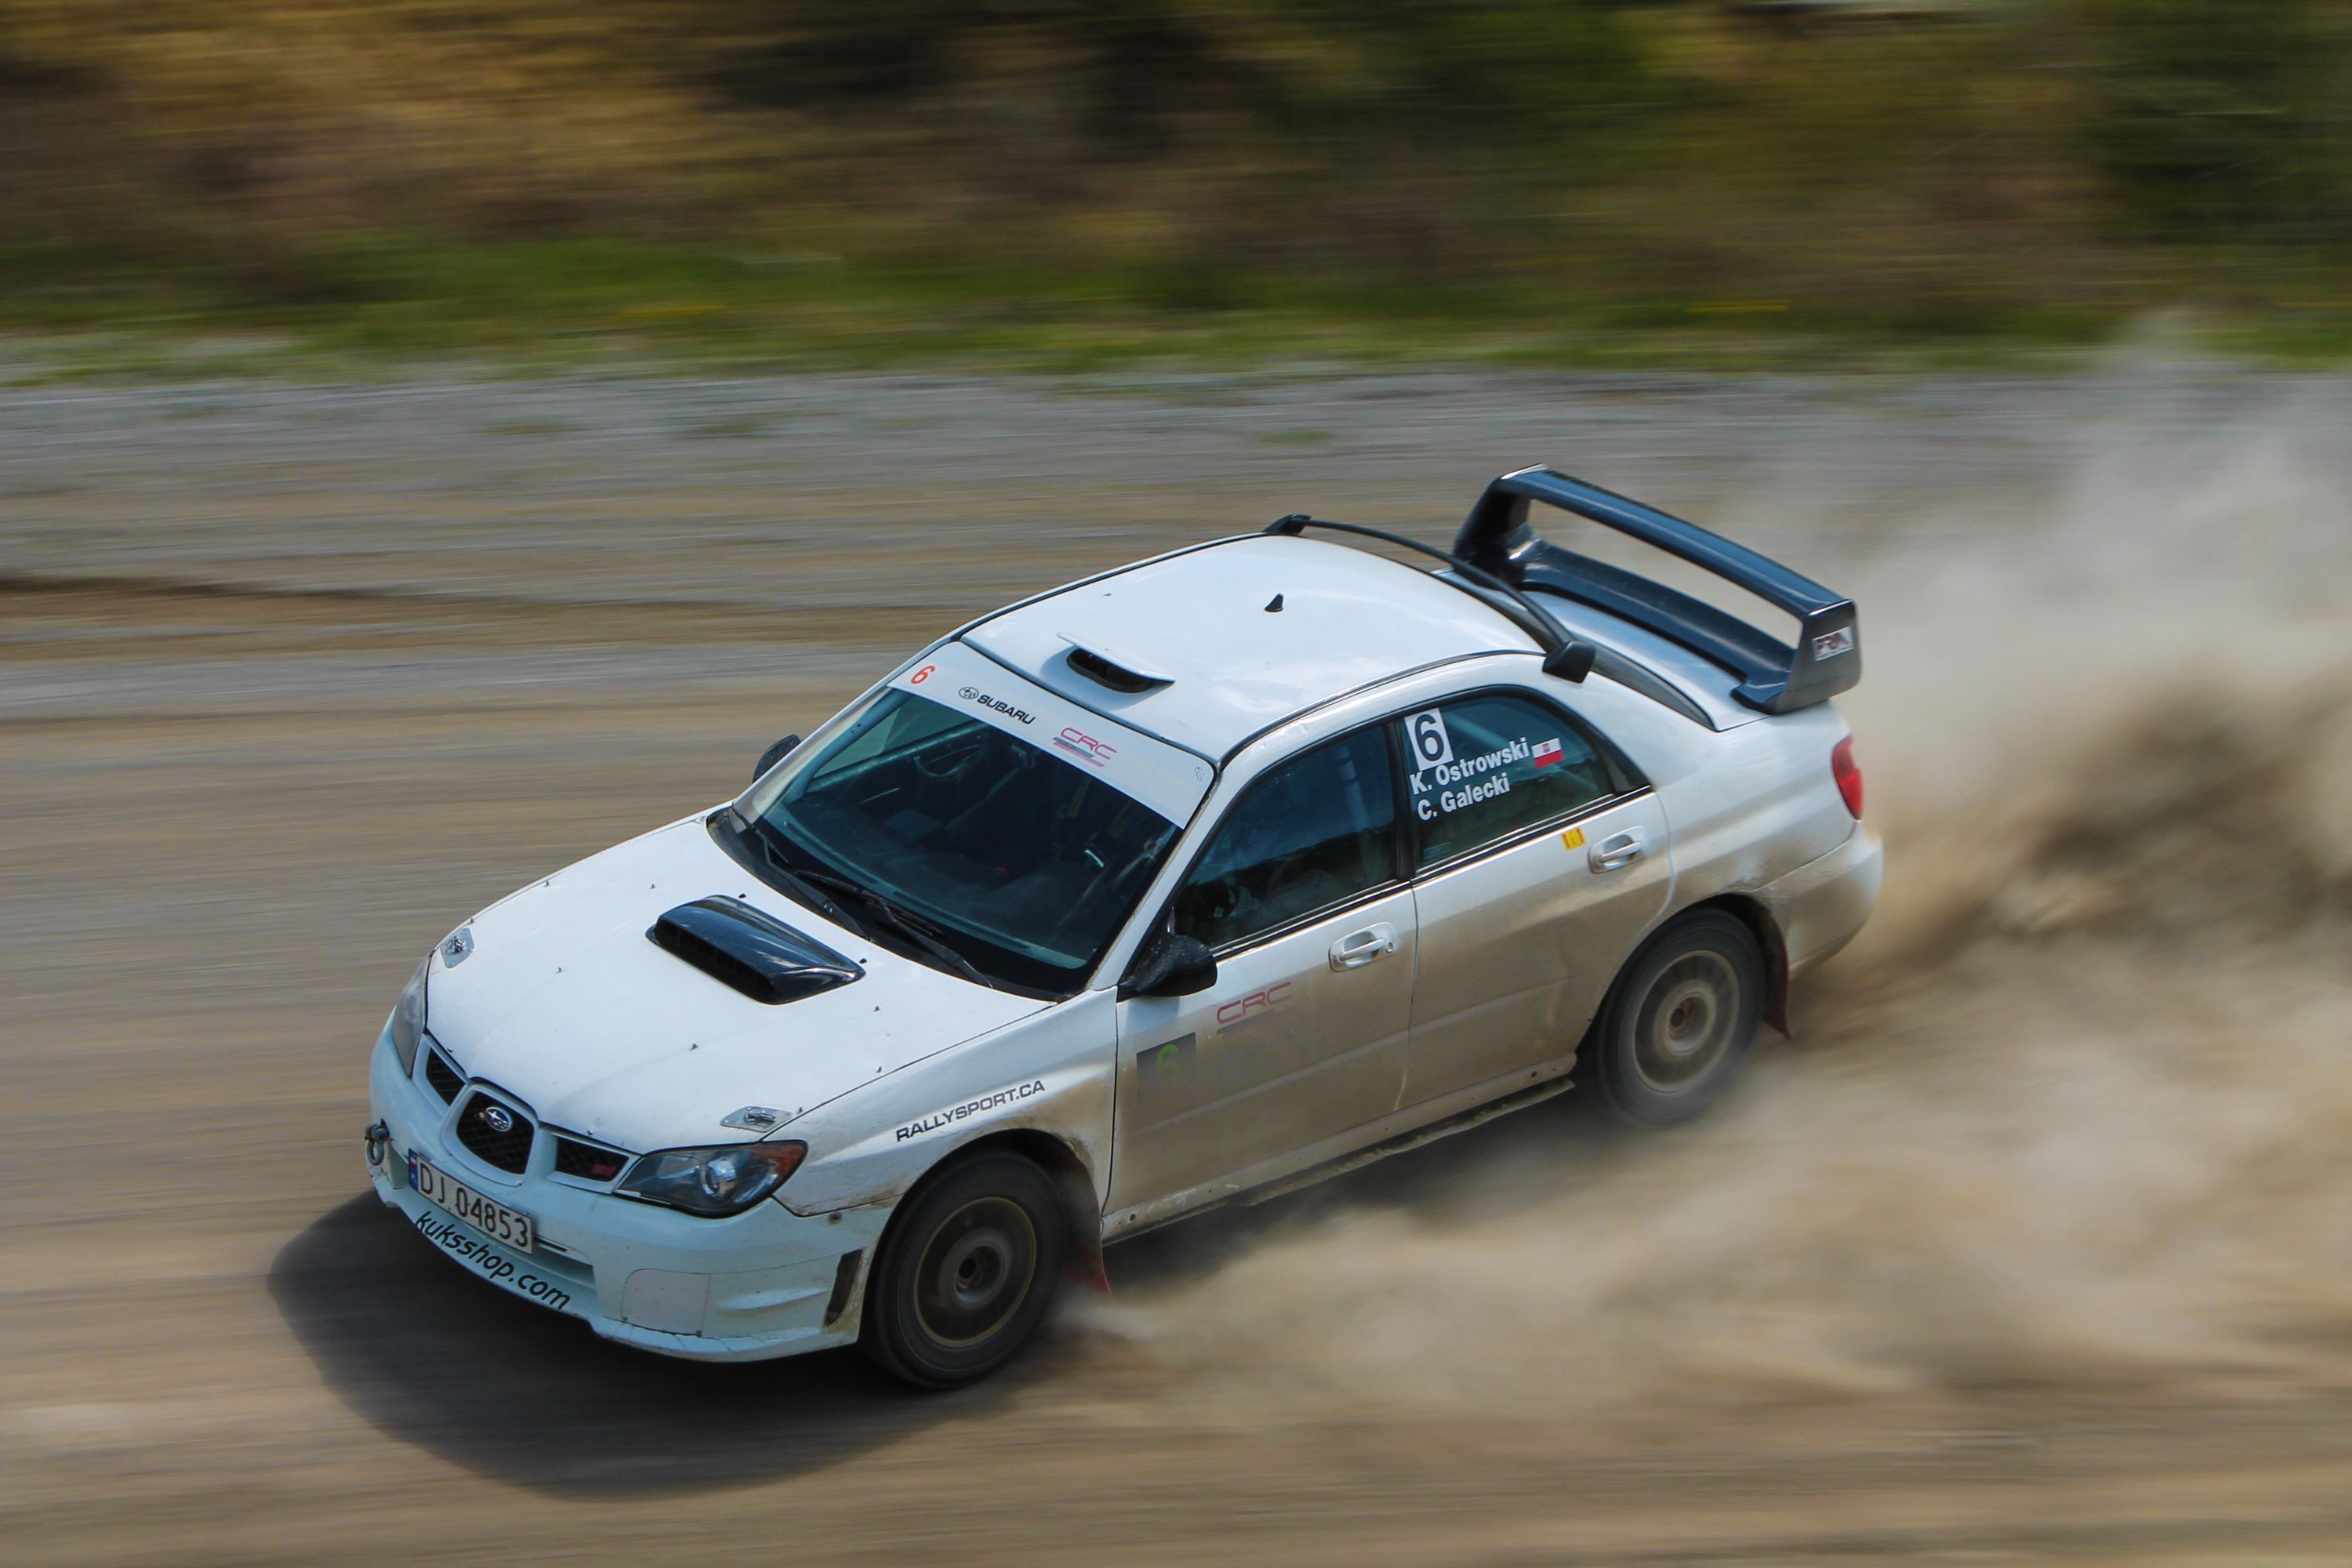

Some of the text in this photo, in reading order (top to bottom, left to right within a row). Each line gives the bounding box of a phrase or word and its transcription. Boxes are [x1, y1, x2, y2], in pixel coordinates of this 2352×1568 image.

[910, 665, 935, 685] 6
[978, 694, 1036, 725] SUBARU
[1060, 727, 1118, 760] CRC
[1414, 713, 1445, 762] 6
[1410, 737, 1530, 796] K. Ostrowski
[1417, 772, 1511, 822] C. Galecki
[1216, 982, 1294, 1025] CRC
[895, 1080, 1046, 1142] RALLYSPORT.CA
[456, 1187, 528, 1247] 04853
[415, 1210, 571, 1311] kuksshop.com
